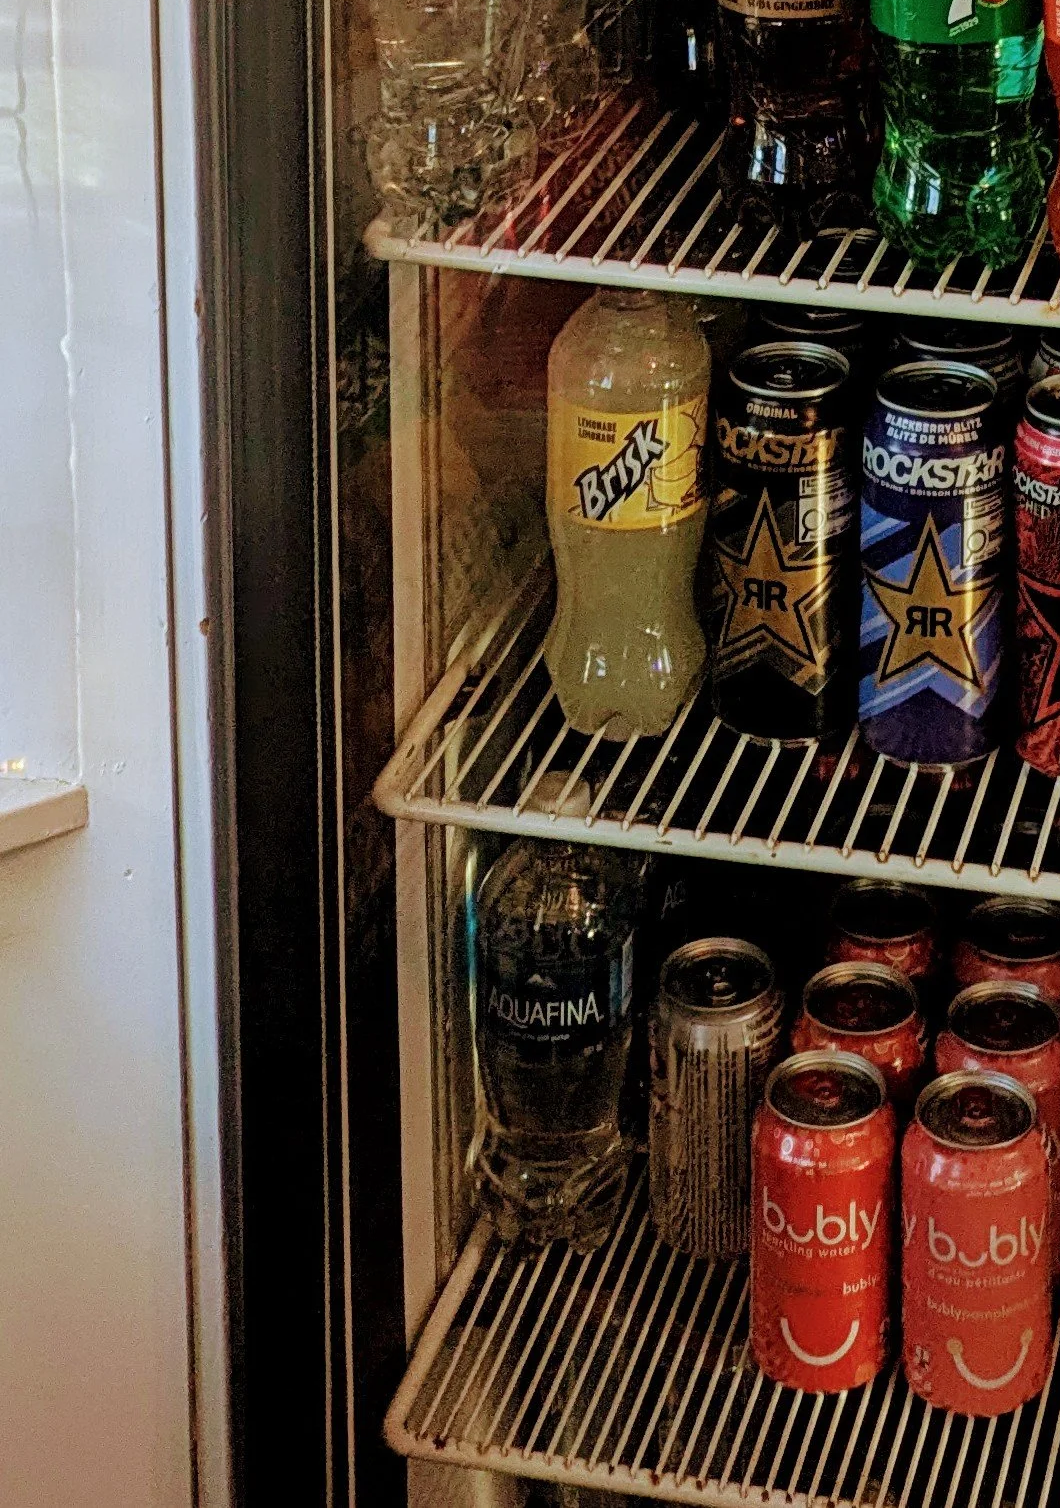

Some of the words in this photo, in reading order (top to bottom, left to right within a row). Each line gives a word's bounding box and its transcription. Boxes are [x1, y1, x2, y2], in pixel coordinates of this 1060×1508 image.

[746, 402, 798, 419] ORIGINAL
[885, 413, 951, 434] BLACKBERRY
[953, 417, 982, 433] BLITZ
[886, 426, 917, 443] BLITZ
[919, 433, 935, 444] DE
[577, 419, 668, 520] Brisk
[862, 437, 1005, 488] ROCKSTAR
[488, 986, 600, 1029] AQUAFINA
